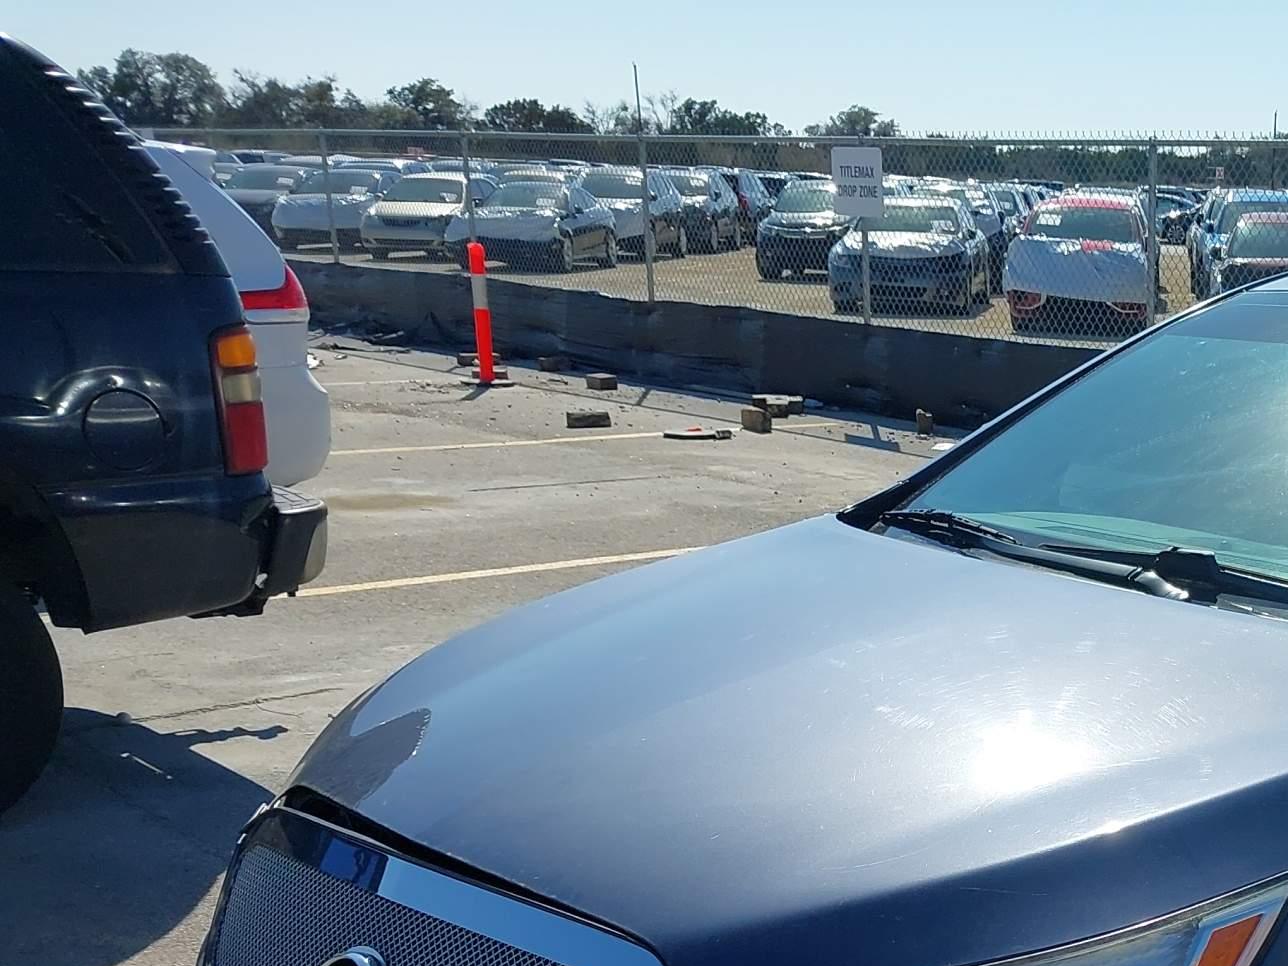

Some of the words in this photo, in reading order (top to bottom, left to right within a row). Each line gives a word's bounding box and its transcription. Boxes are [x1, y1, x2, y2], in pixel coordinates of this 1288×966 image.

[839, 165, 876, 179] TITLEMAX
[837, 184, 857, 198] DROP
[859, 185, 878, 199] ZONE
